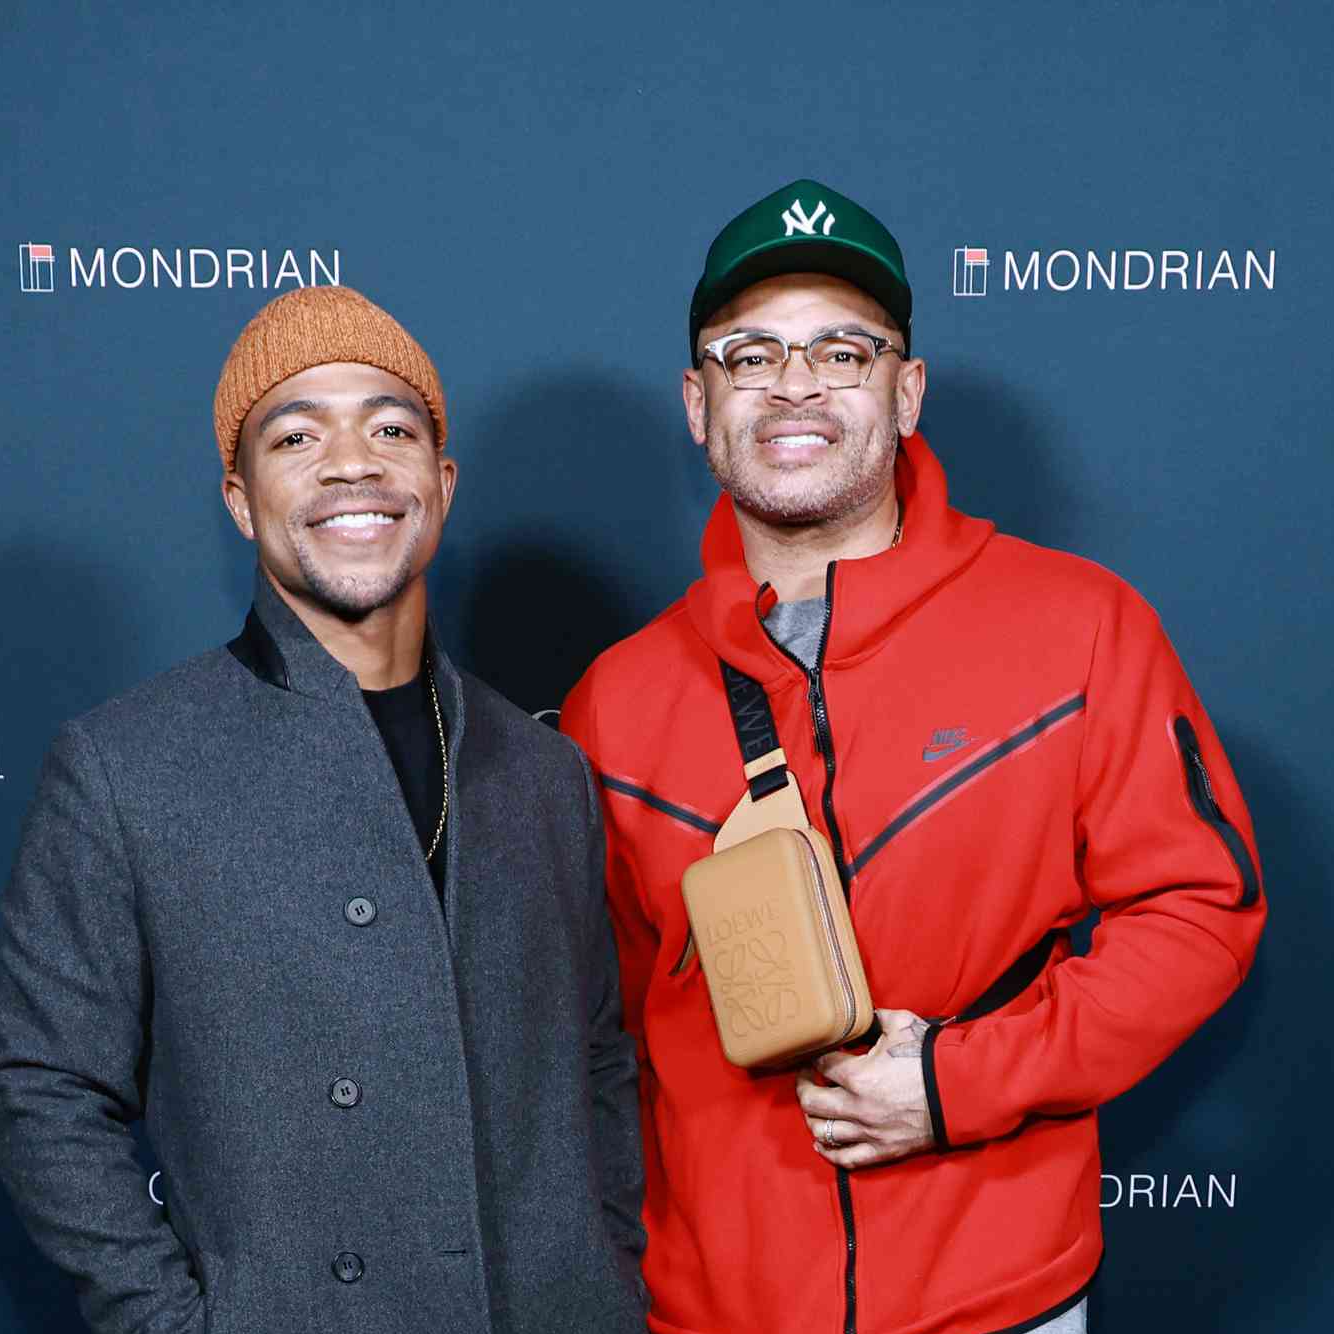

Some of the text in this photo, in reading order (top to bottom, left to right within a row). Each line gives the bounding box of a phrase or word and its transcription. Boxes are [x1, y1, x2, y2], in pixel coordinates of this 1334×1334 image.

[70, 246, 341, 289] MONDRIAN
[1004, 249, 1276, 292] MONDRIAN
[1099, 1173, 1236, 1208] DRIAN
